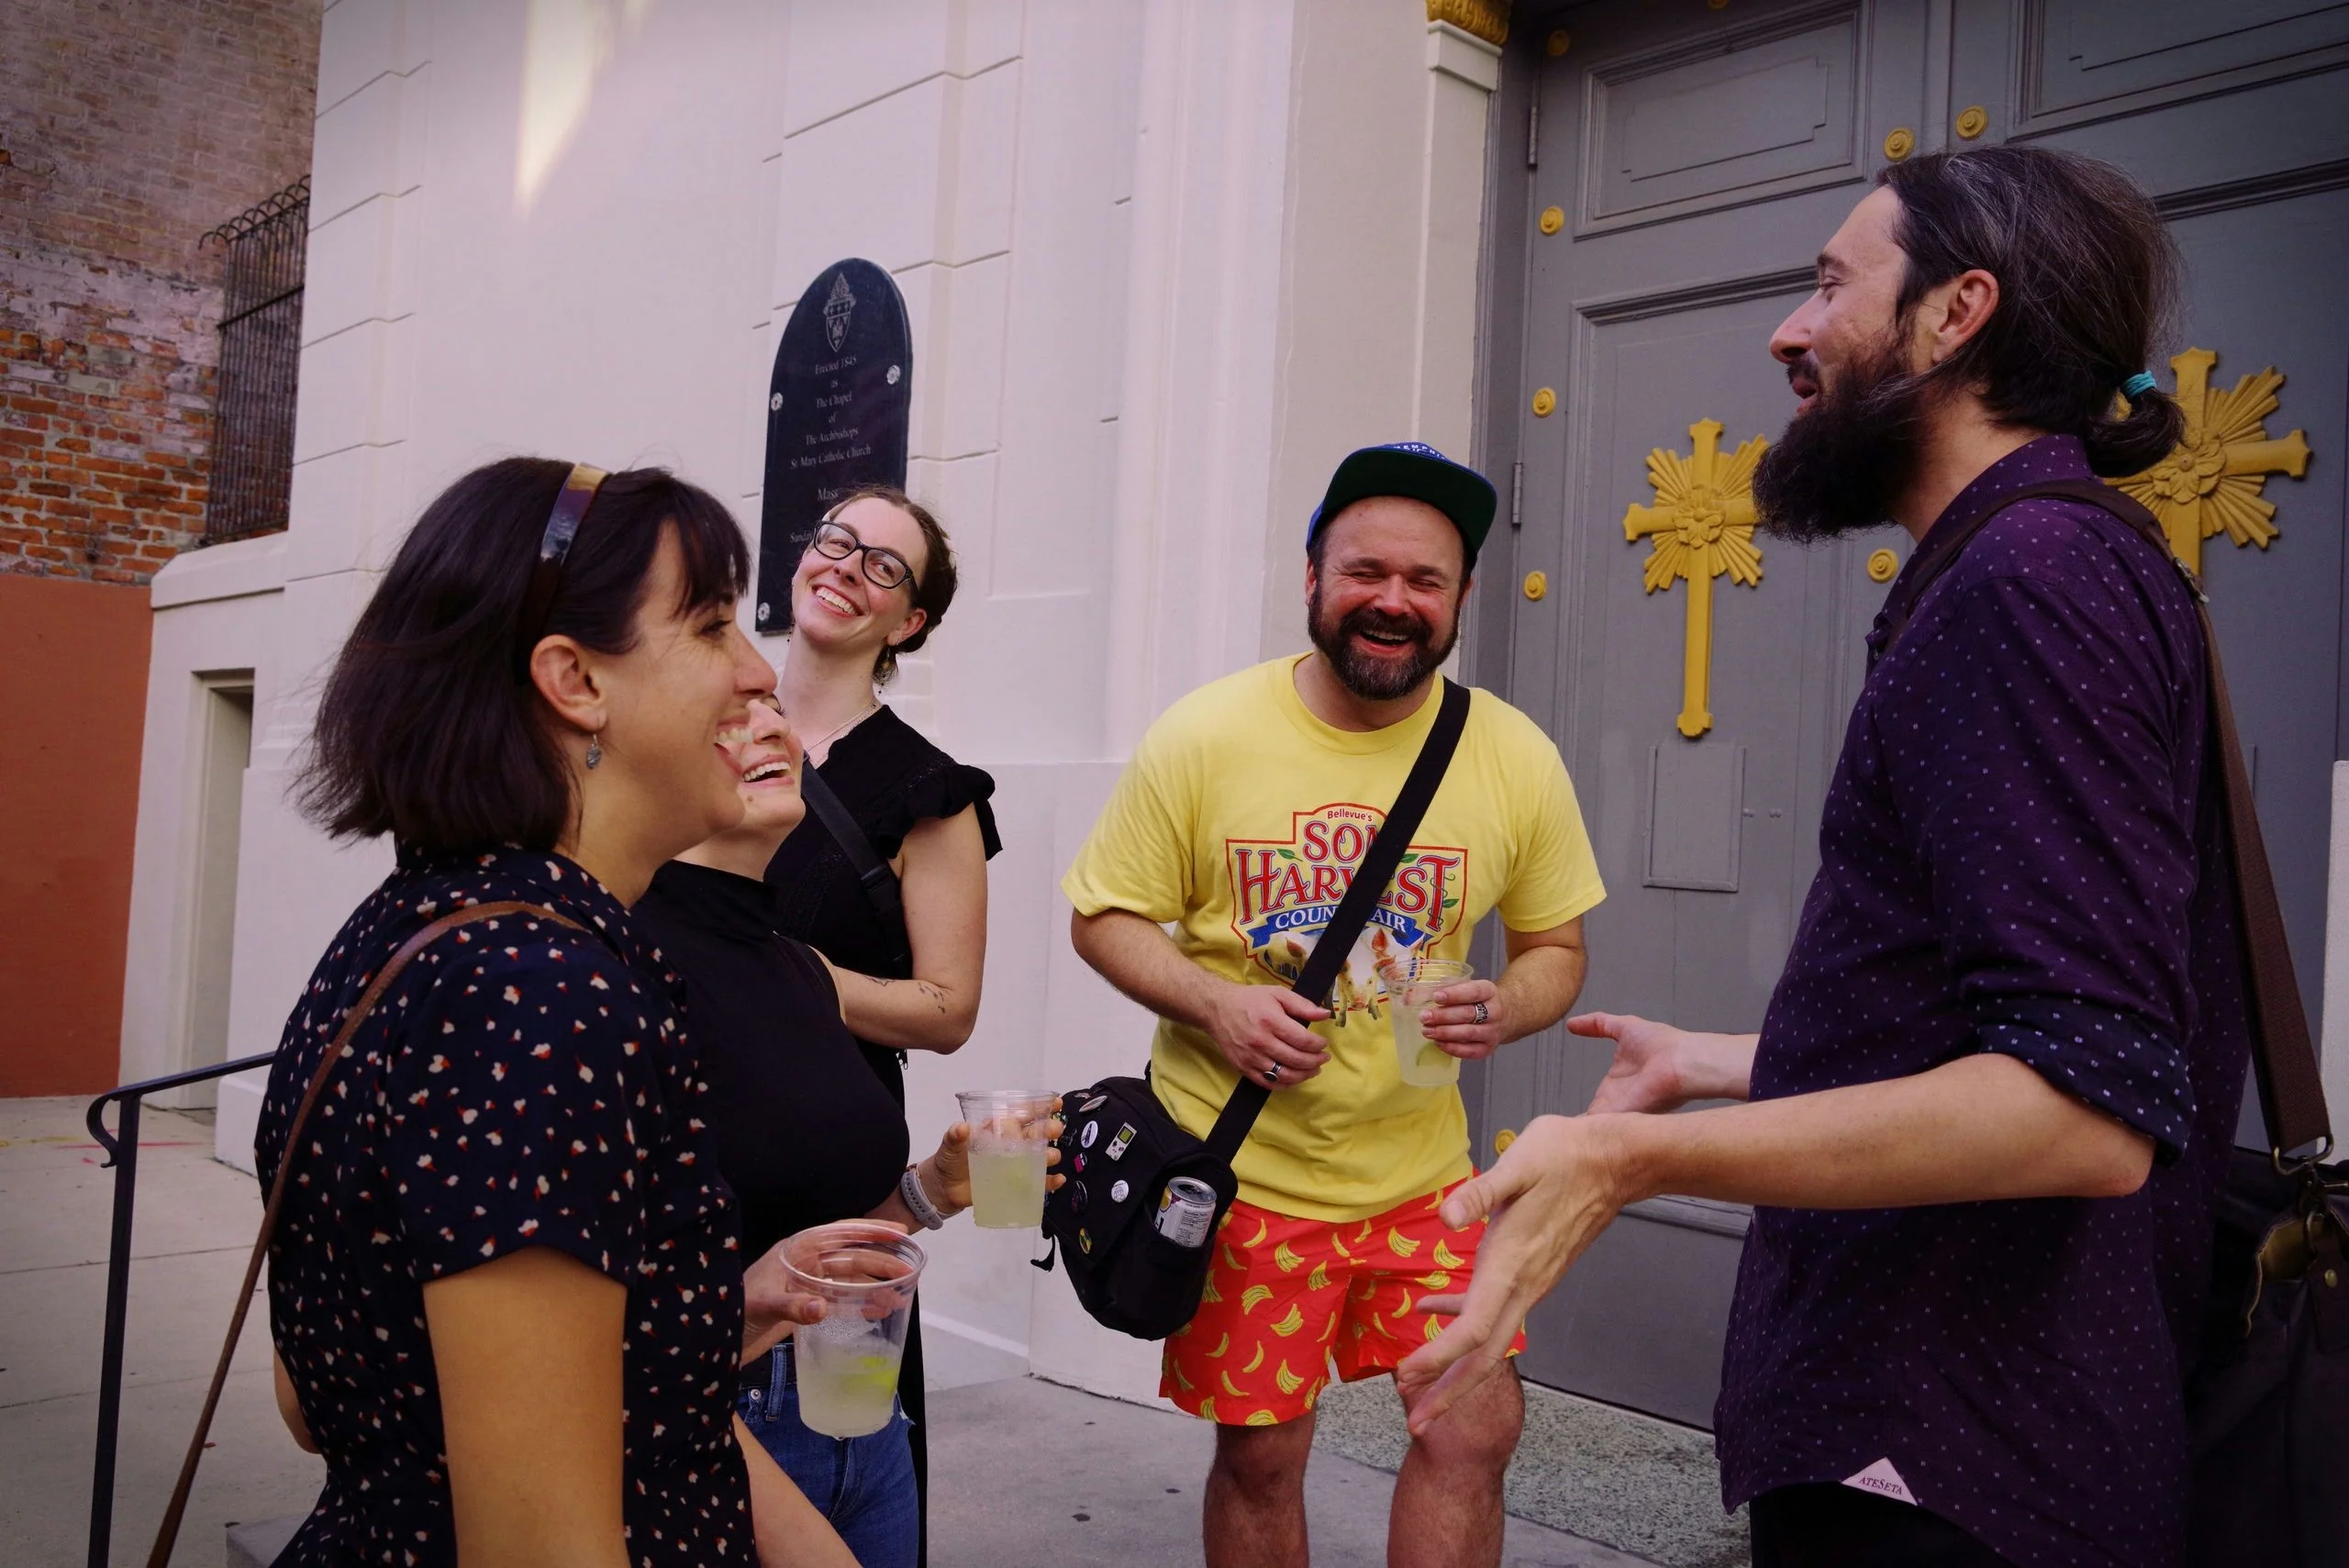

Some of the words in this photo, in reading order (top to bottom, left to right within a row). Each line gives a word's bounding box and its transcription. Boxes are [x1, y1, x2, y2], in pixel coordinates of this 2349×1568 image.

[816, 396, 828, 408] The
[829, 391, 852, 406] Chapel
[828, 411, 837, 423] of
[806, 433, 817, 446] The
[800, 456, 817, 468] Mary
[818, 449, 844, 463] Catholic
[846, 443, 872, 459] Church
[1327, 807, 1373, 822] Bellevue's
[1275, 906, 1339, 930] COUN
[1370, 906, 1407, 933] AIR
